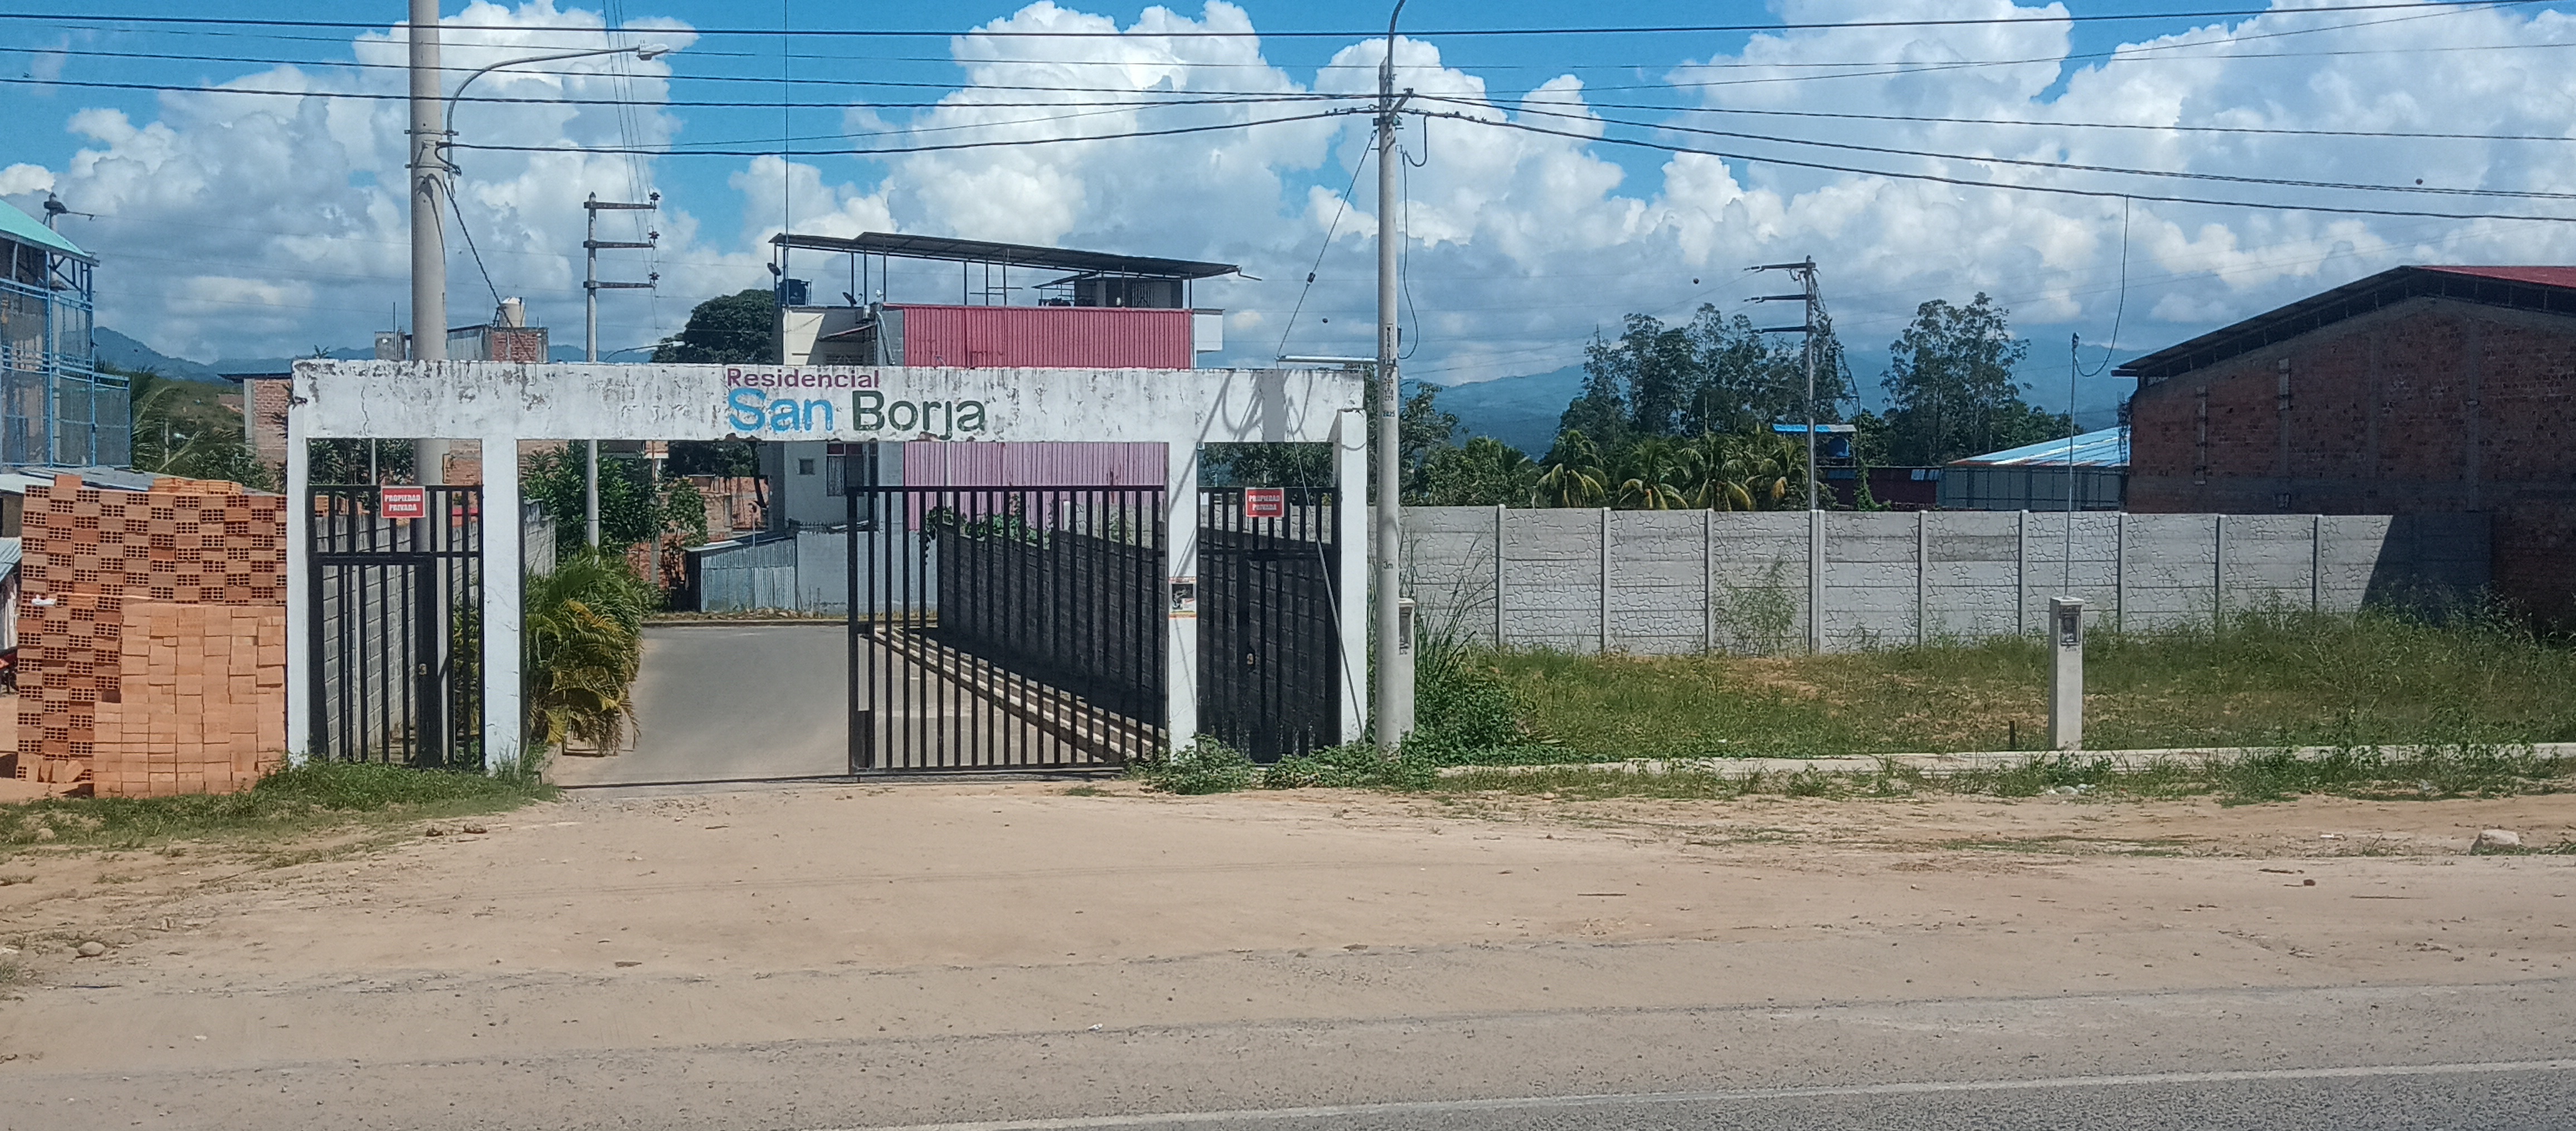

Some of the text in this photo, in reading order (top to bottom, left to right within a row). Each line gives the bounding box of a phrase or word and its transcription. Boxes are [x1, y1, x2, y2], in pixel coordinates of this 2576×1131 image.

[726, 368, 879, 388] Residencial
[728, 388, 986, 440] San Borja
